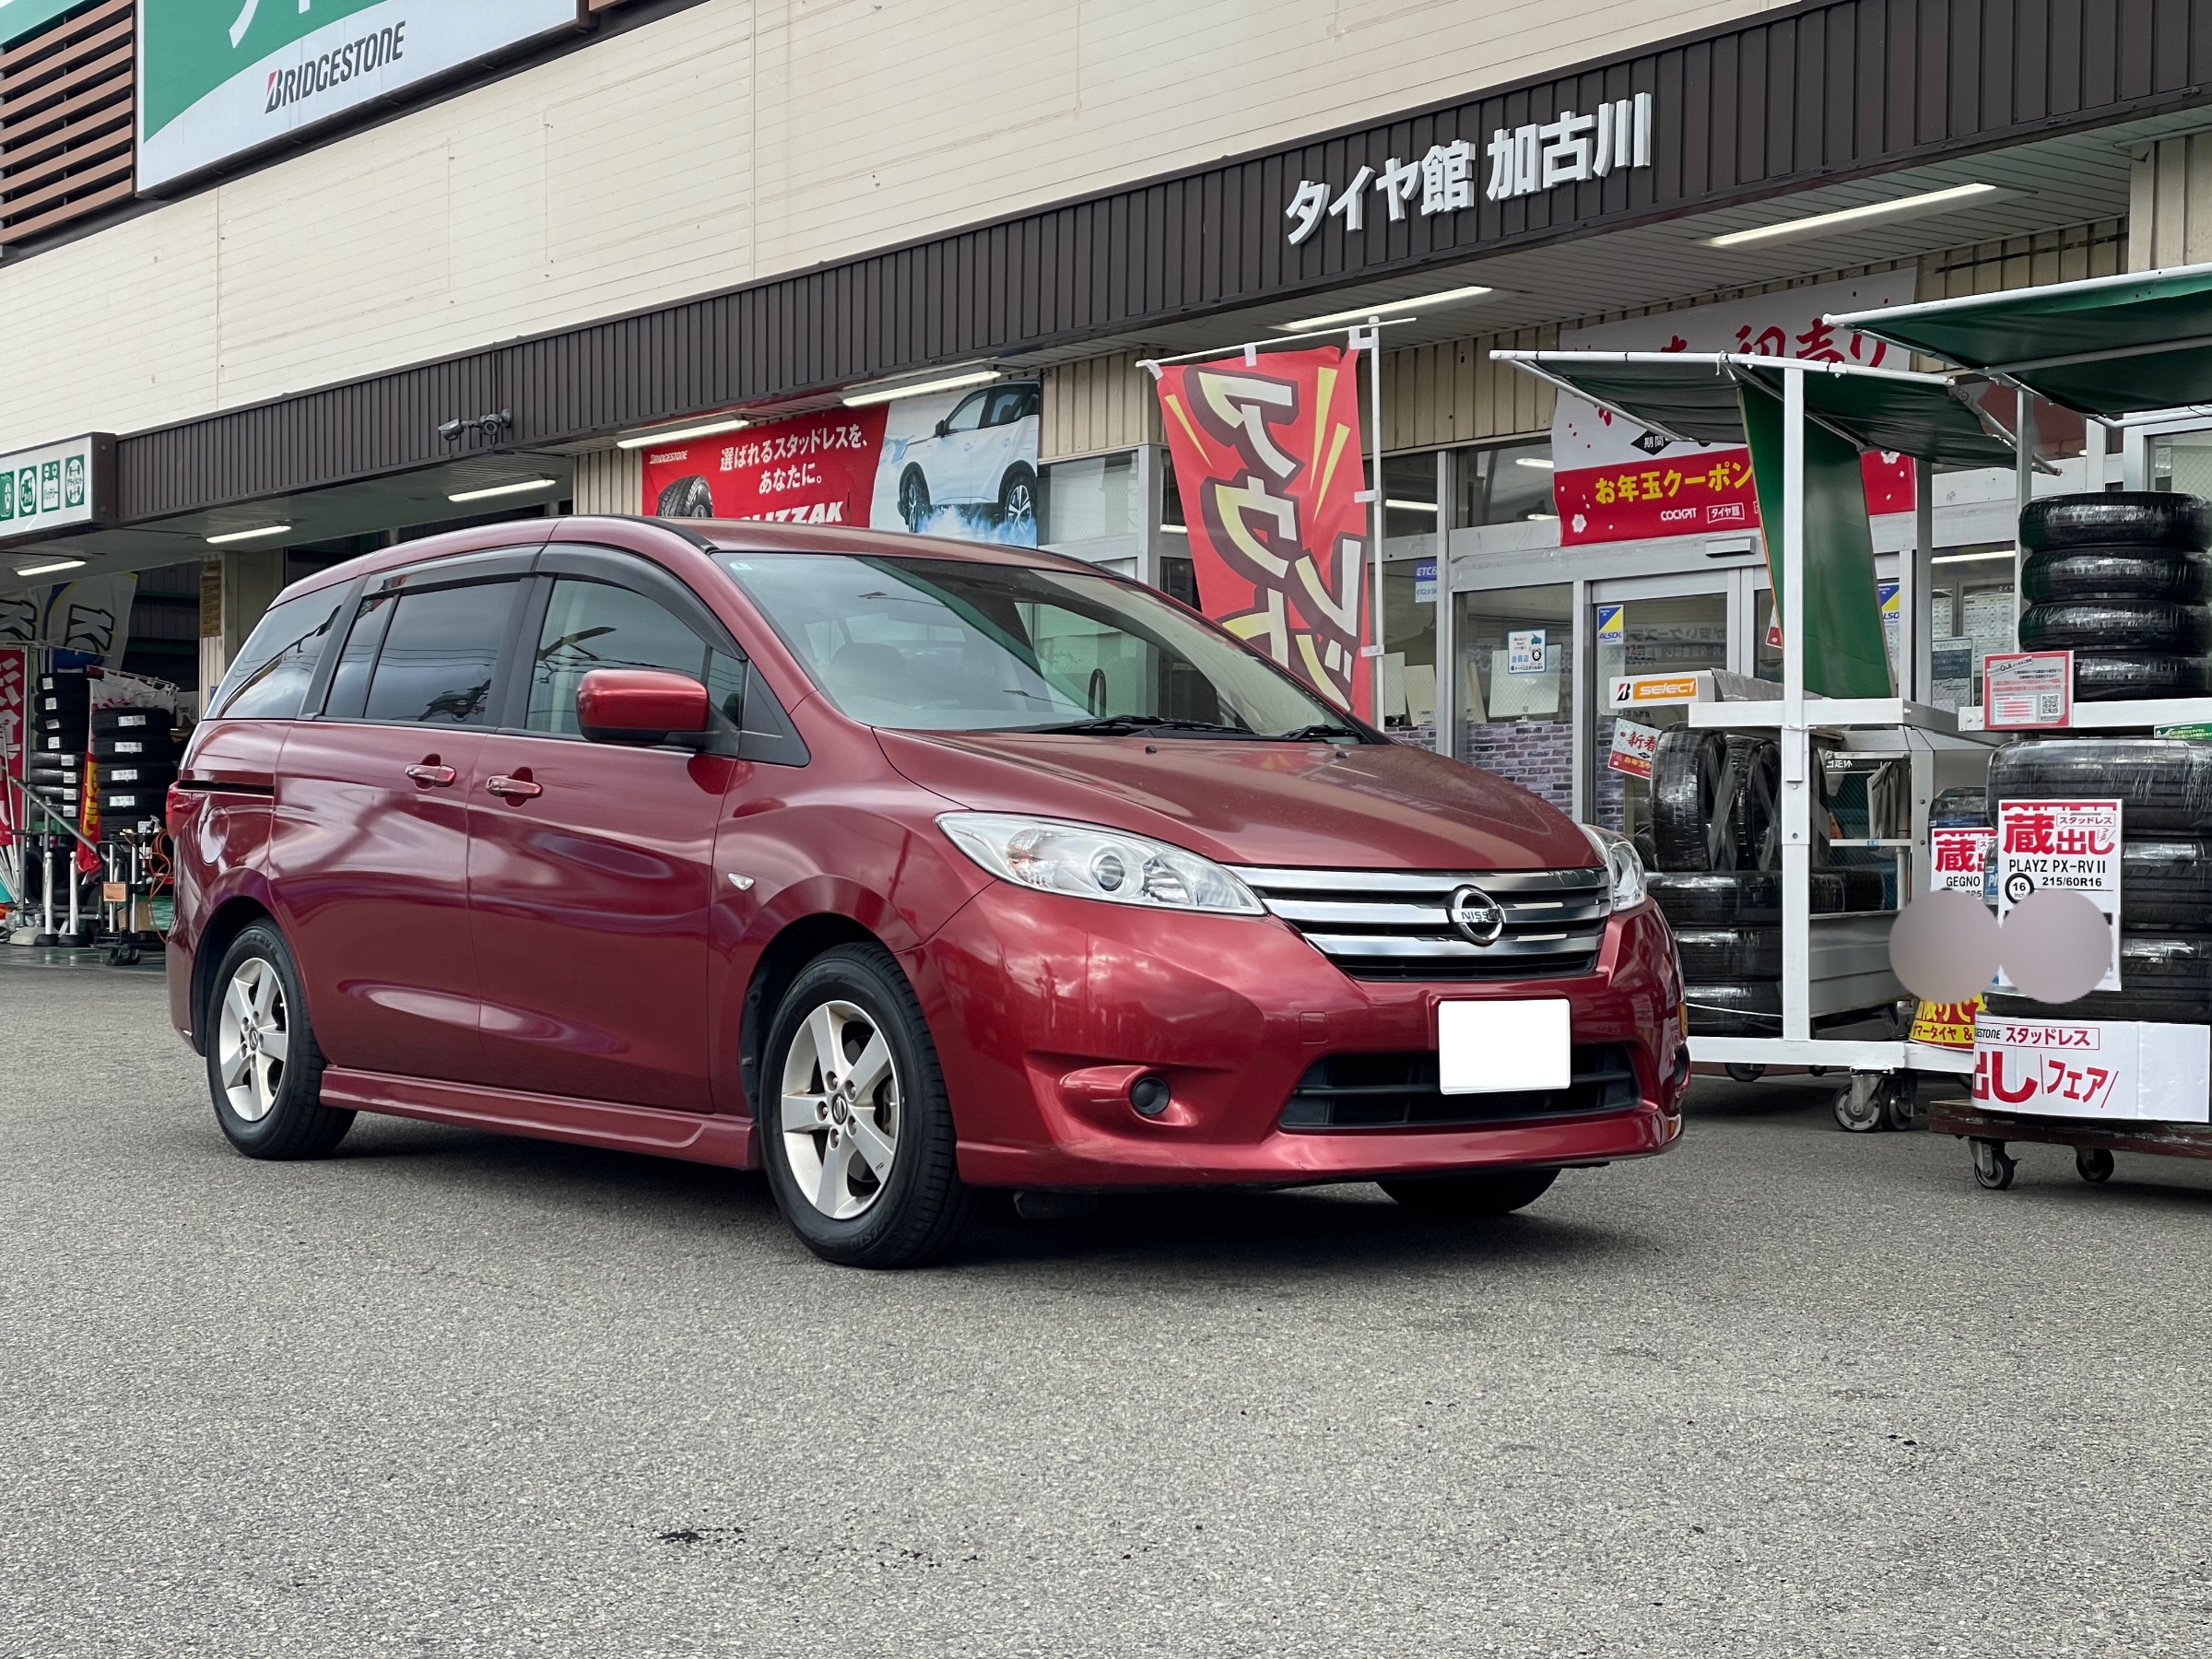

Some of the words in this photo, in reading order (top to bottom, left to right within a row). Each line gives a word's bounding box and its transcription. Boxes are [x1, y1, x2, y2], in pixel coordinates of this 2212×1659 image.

[265, 20, 406, 113] BRIDGESTONE
[1285, 139, 1475, 245] タイヤ館
[1487, 92, 1652, 202] 加古川
[720, 423, 867, 472] 選ばれるスタッドレスを、
[649, 450, 688, 465] BRIDGESTONE
[759, 463, 822, 495] あなたに。
[1595, 461, 1753, 505] お年玉クーポン
[740, 501, 843, 524] ZZAK
[1660, 507, 1698, 521] COCKPIT
[1710, 505, 1742, 519] タイヤ館
[1882, 611, 1900, 619] LSO
[1599, 631, 1622, 640] ALSOK
[1640, 680, 1696, 696] select
[2059, 816, 2112, 825] スタッドレス
[2002, 813, 2116, 856] 蔵出し
[2008, 859, 2048, 873] PLAYZ
[1946, 876, 1981, 887] GEGNO
[2013, 882, 2026, 891] 16
[2041, 877, 2102, 887] 215/60R16
[1963, 1027, 1974, 1041] &
[2006, 1026, 2091, 1047] スタッドレス
[2047, 1059, 2109, 1103] フェア
